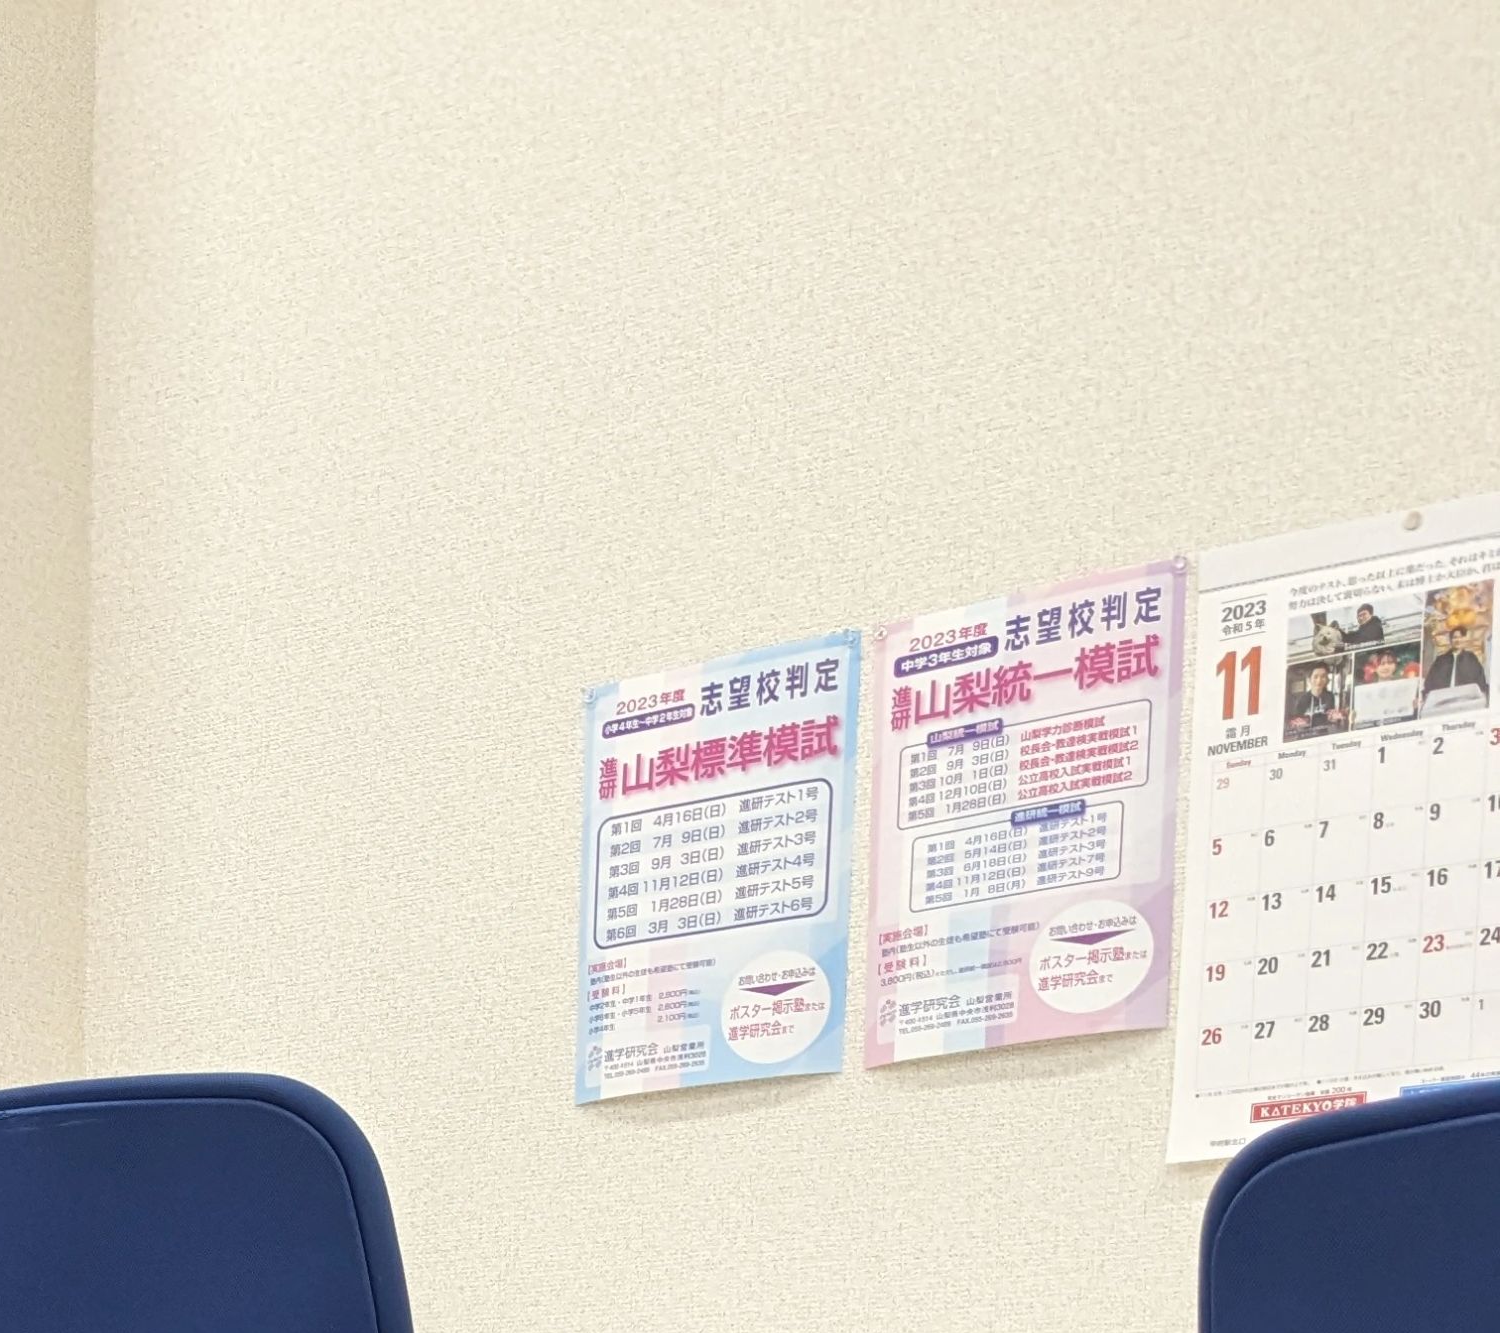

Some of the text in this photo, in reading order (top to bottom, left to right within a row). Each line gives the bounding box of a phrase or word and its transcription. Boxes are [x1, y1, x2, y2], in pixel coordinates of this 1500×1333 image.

[1004, 587, 1162, 651] 志望校判定
[1222, 600, 1267, 623] 2023
[1222, 618, 1265, 636] 令和5年
[901, 641, 992, 672] 中学3年生対象
[910, 622, 988, 652] 2023年度
[700, 658, 840, 716] 志望校判定
[914, 634, 1160, 725] 山梨統一模試
[1216, 645, 1262, 720] 11
[616, 688, 686, 715] 2023年度
[891, 685, 911, 731] 進研
[910, 750, 938, 764] 第1回
[1020, 716, 1105, 742] 山梨学力診断模試
[1207, 736, 1268, 757] NOVEMBER
[1225, 725, 1250, 739] 霜月
[1226, 758, 1251, 769] Sunday
[1278, 749, 1306, 760] Monday
[1332, 740, 1361, 751] Tuesday
[1380, 728, 1423, 742] Wednesday
[621, 715, 839, 796] 山梨標準模試
[910, 764, 937, 779] 第2回
[1216, 778, 1230, 790] 29
[1269, 767, 1283, 780] 30
[1323, 759, 1337, 771] 31
[1378, 747, 1386, 764] 1
[1432, 737, 1444, 755] 2
[598, 757, 618, 799] 進研
[909, 779, 936, 793] 第3回
[611, 819, 642, 837] 第1回
[739, 787, 819, 813] 進研テスト1号
[908, 808, 935, 822] 第5回
[909, 793, 935, 808] 第4回
[610, 840, 641, 858] 第2回
[738, 809, 818, 835] 進研テスト2号
[927, 841, 955, 854] 第1回
[1211, 838, 1222, 856] 5
[1264, 829, 1275, 847] 6
[1319, 820, 1329, 838] 7
[1373, 811, 1384, 829] 8
[1429, 803, 1440, 821] 9
[609, 861, 640, 879] 第3回
[737, 831, 817, 857] 進研テスト3号
[926, 867, 954, 879] 第3回
[927, 854, 955, 866] 第2回
[608, 882, 639, 900] 第4回
[736, 853, 815, 879] 進研テスト4号
[925, 879, 953, 892] 第4回
[1209, 900, 1229, 919] 12
[1262, 892, 1282, 911] 13
[1315, 884, 1336, 903] 14
[1371, 876, 1392, 895] 15
[1426, 868, 1448, 887] 16
[607, 904, 638, 921] 第5回
[734, 875, 815, 900] 進研テスト5号
[925, 892, 953, 905] 第5回
[606, 925, 637, 942] 第6回
[734, 897, 813, 922] 進研テスト6号
[1206, 964, 1226, 982] 19
[1257, 956, 1278, 975] 20
[1311, 949, 1331, 968] 21
[1366, 941, 1389, 961] 22
[1422, 934, 1445, 953] 23
[1479, 926, 1500, 946] 24
[1038, 969, 1113, 991] 進学研究会まで
[899, 994, 960, 1017] 進学研究会
[1201, 1027, 1222, 1046] 26
[1254, 1020, 1275, 1039] 27
[1308, 1014, 1330, 1033] 28
[1363, 1007, 1385, 1026] 29
[1419, 1000, 1441, 1019] 30
[604, 1042, 659, 1062] 進学研究会
